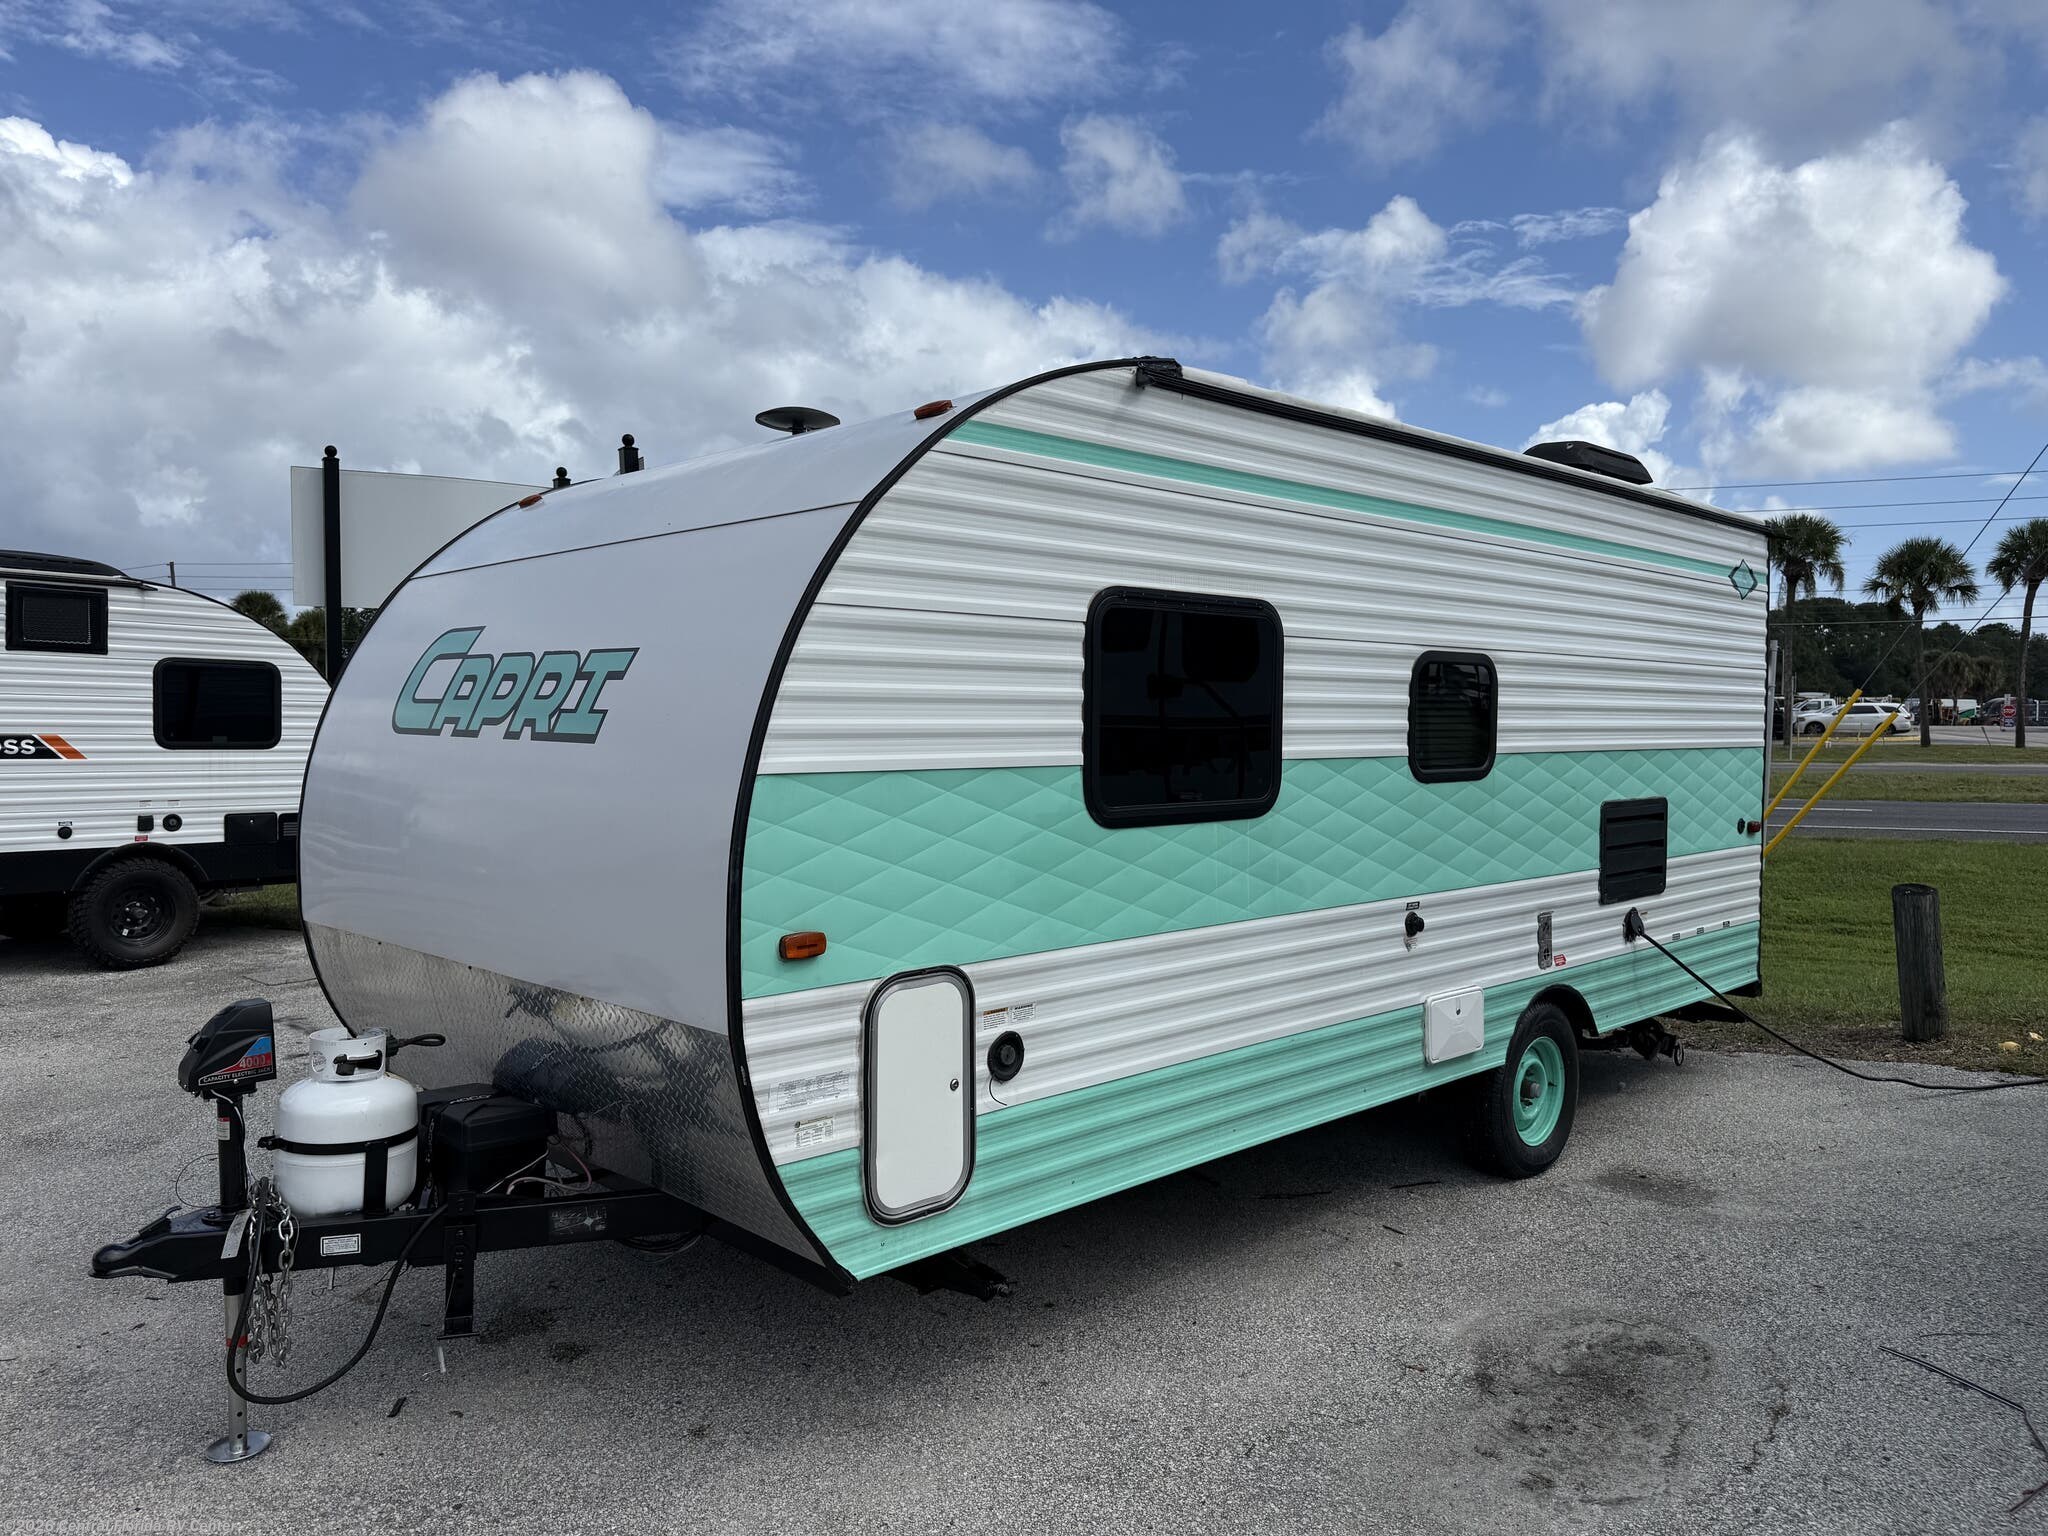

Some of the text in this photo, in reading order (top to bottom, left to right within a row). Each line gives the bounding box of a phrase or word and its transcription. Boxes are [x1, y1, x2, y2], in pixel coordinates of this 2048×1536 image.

[392, 626, 640, 744] CAPRI
[0, 739, 36, 755] SS
[240, 1055, 266, 1069] 4000
[203, 1073, 231, 1082] CAPACITY
